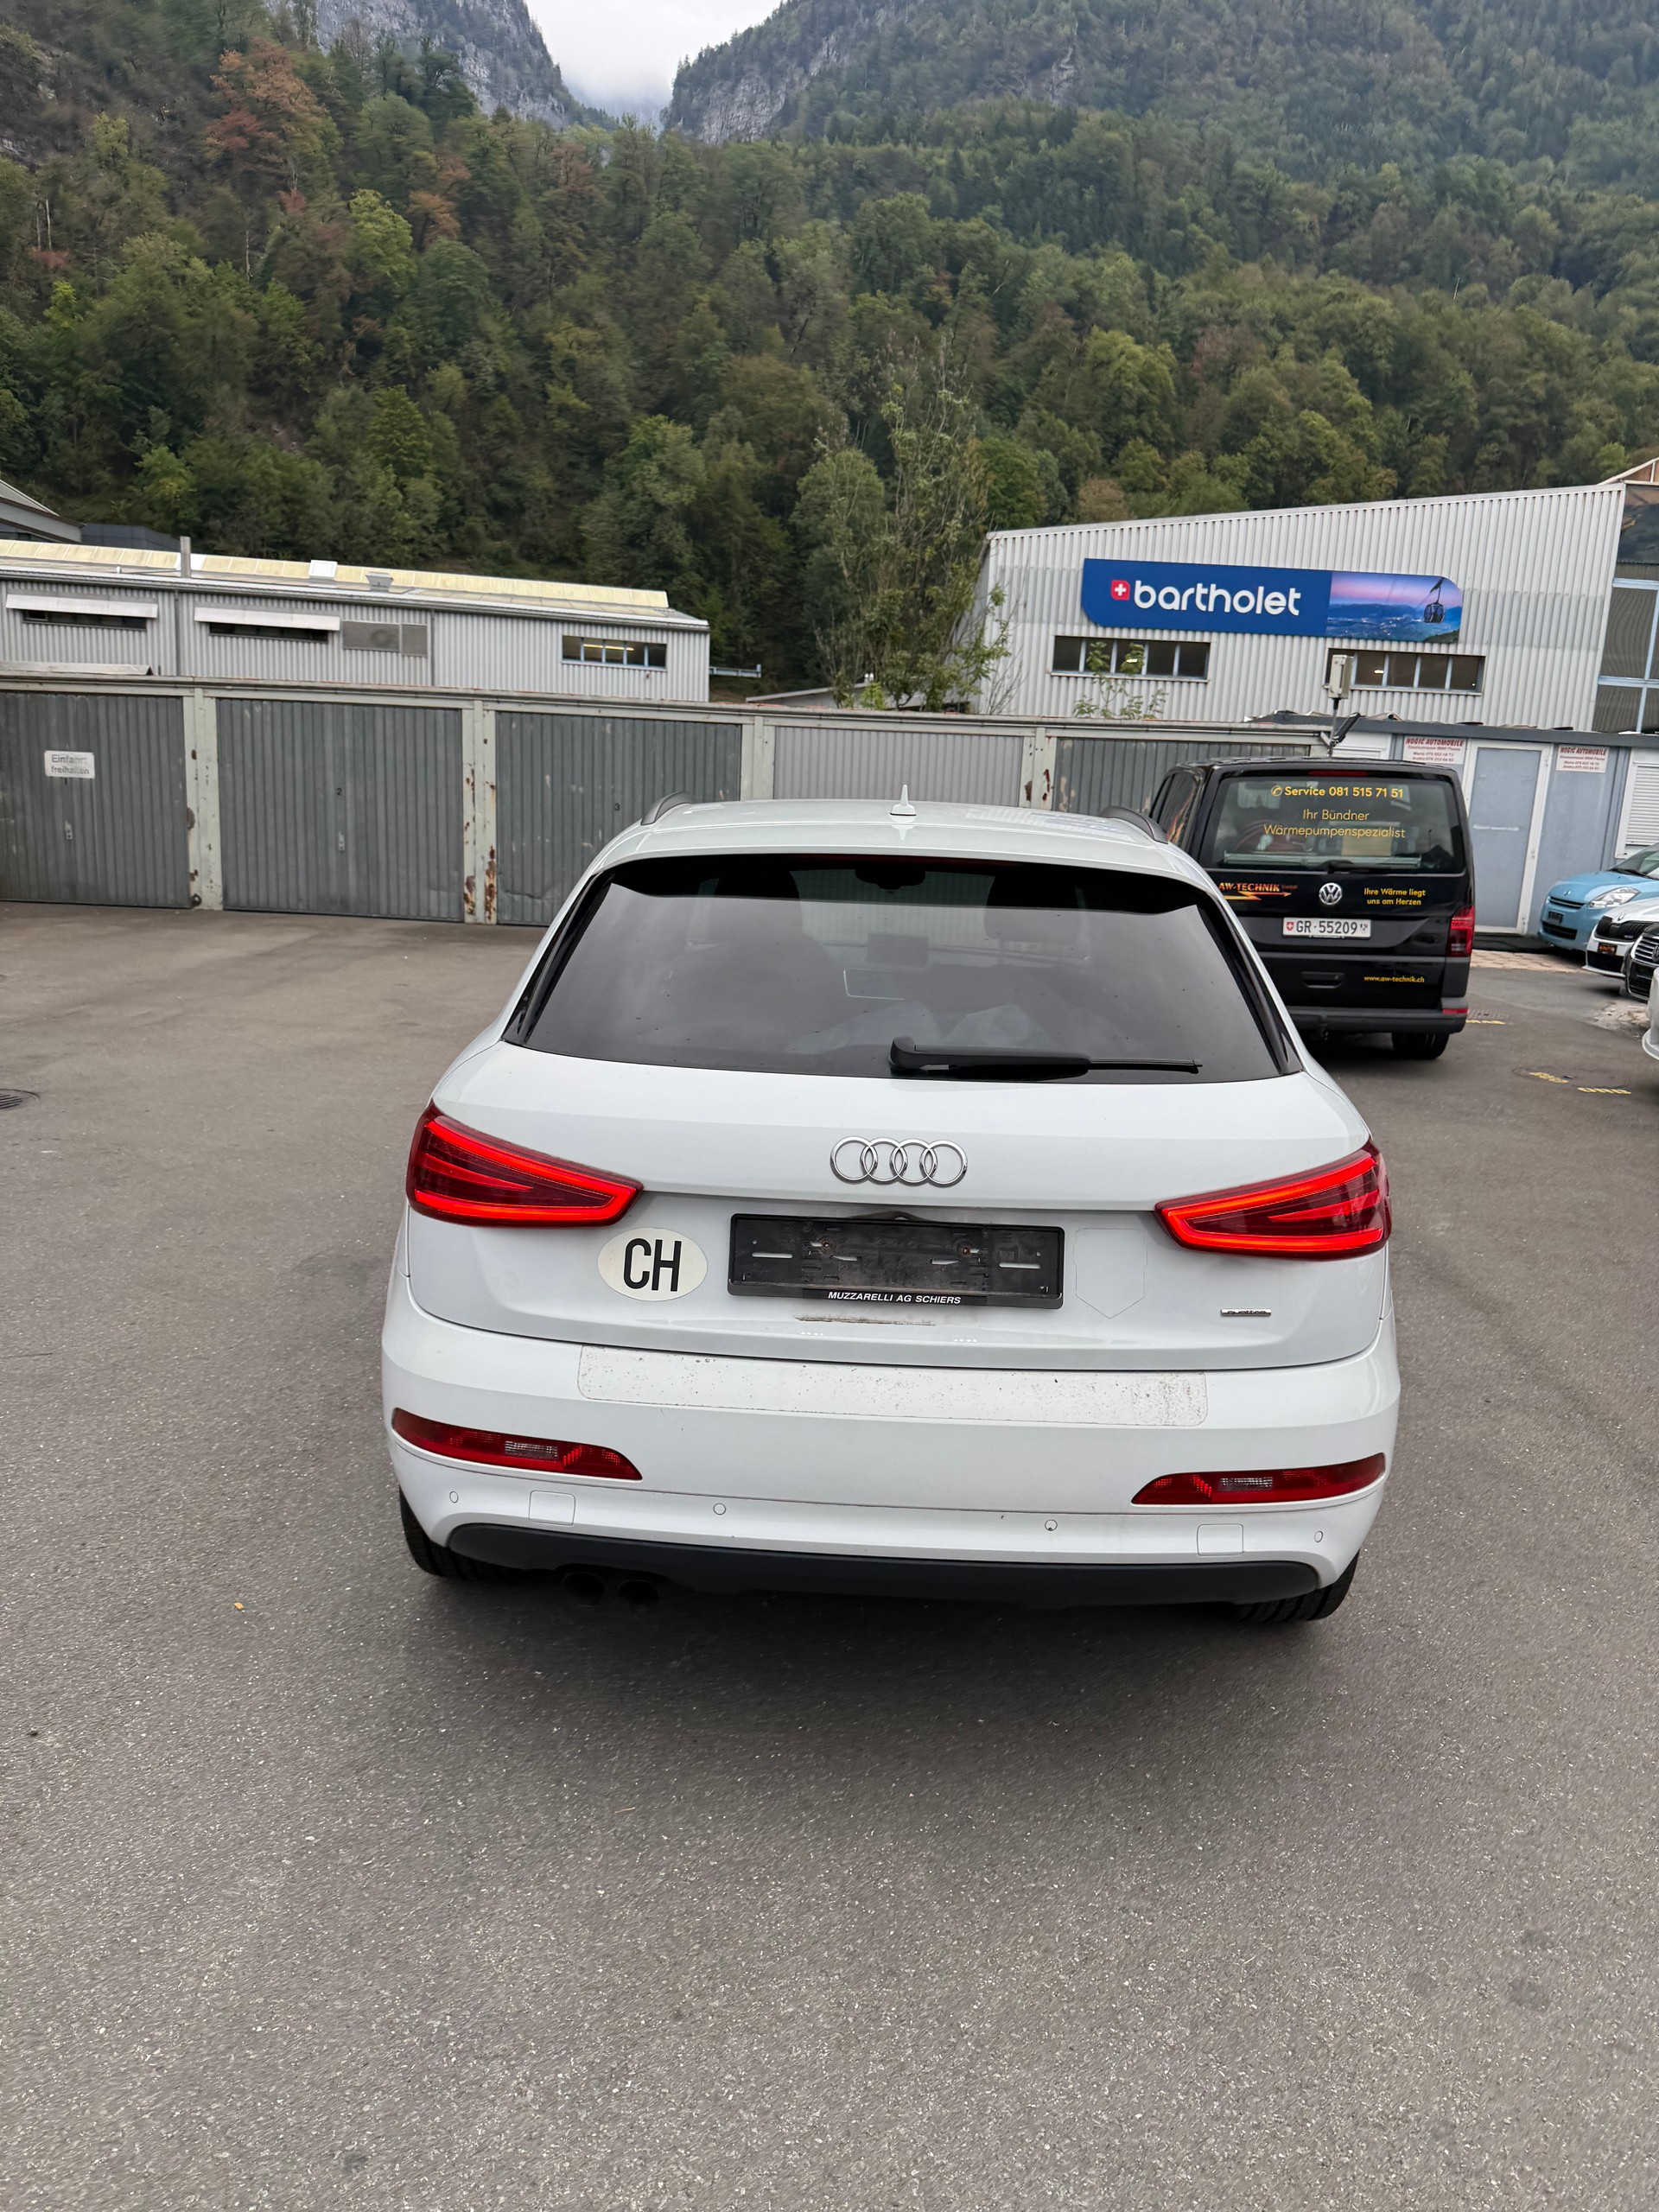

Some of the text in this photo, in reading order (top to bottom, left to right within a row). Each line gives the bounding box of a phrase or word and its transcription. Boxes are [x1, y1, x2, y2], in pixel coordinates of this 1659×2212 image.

[1134, 580, 1301, 616] bartholet
[1425, 738, 1465, 747] AUTOMOBILE
[51, 765, 90, 775] freihaen
[336, 787, 343, 796] 2
[1284, 785, 1403, 798] Service 081 515 71 51
[614, 803, 620, 811] 3
[1302, 809, 1370, 821] Ihr Bündner
[1263, 823, 1406, 839] Wärmepumpenspezialist
[1218, 882, 1280, 892] AW-TECHNIK
[1408, 888, 1426, 898] liegt
[1363, 975, 1425, 983] www.aw-technik.ch
[623, 1236, 682, 1293] CH
[828, 1291, 962, 1305] MUZZARELLI AG SCHIERS
